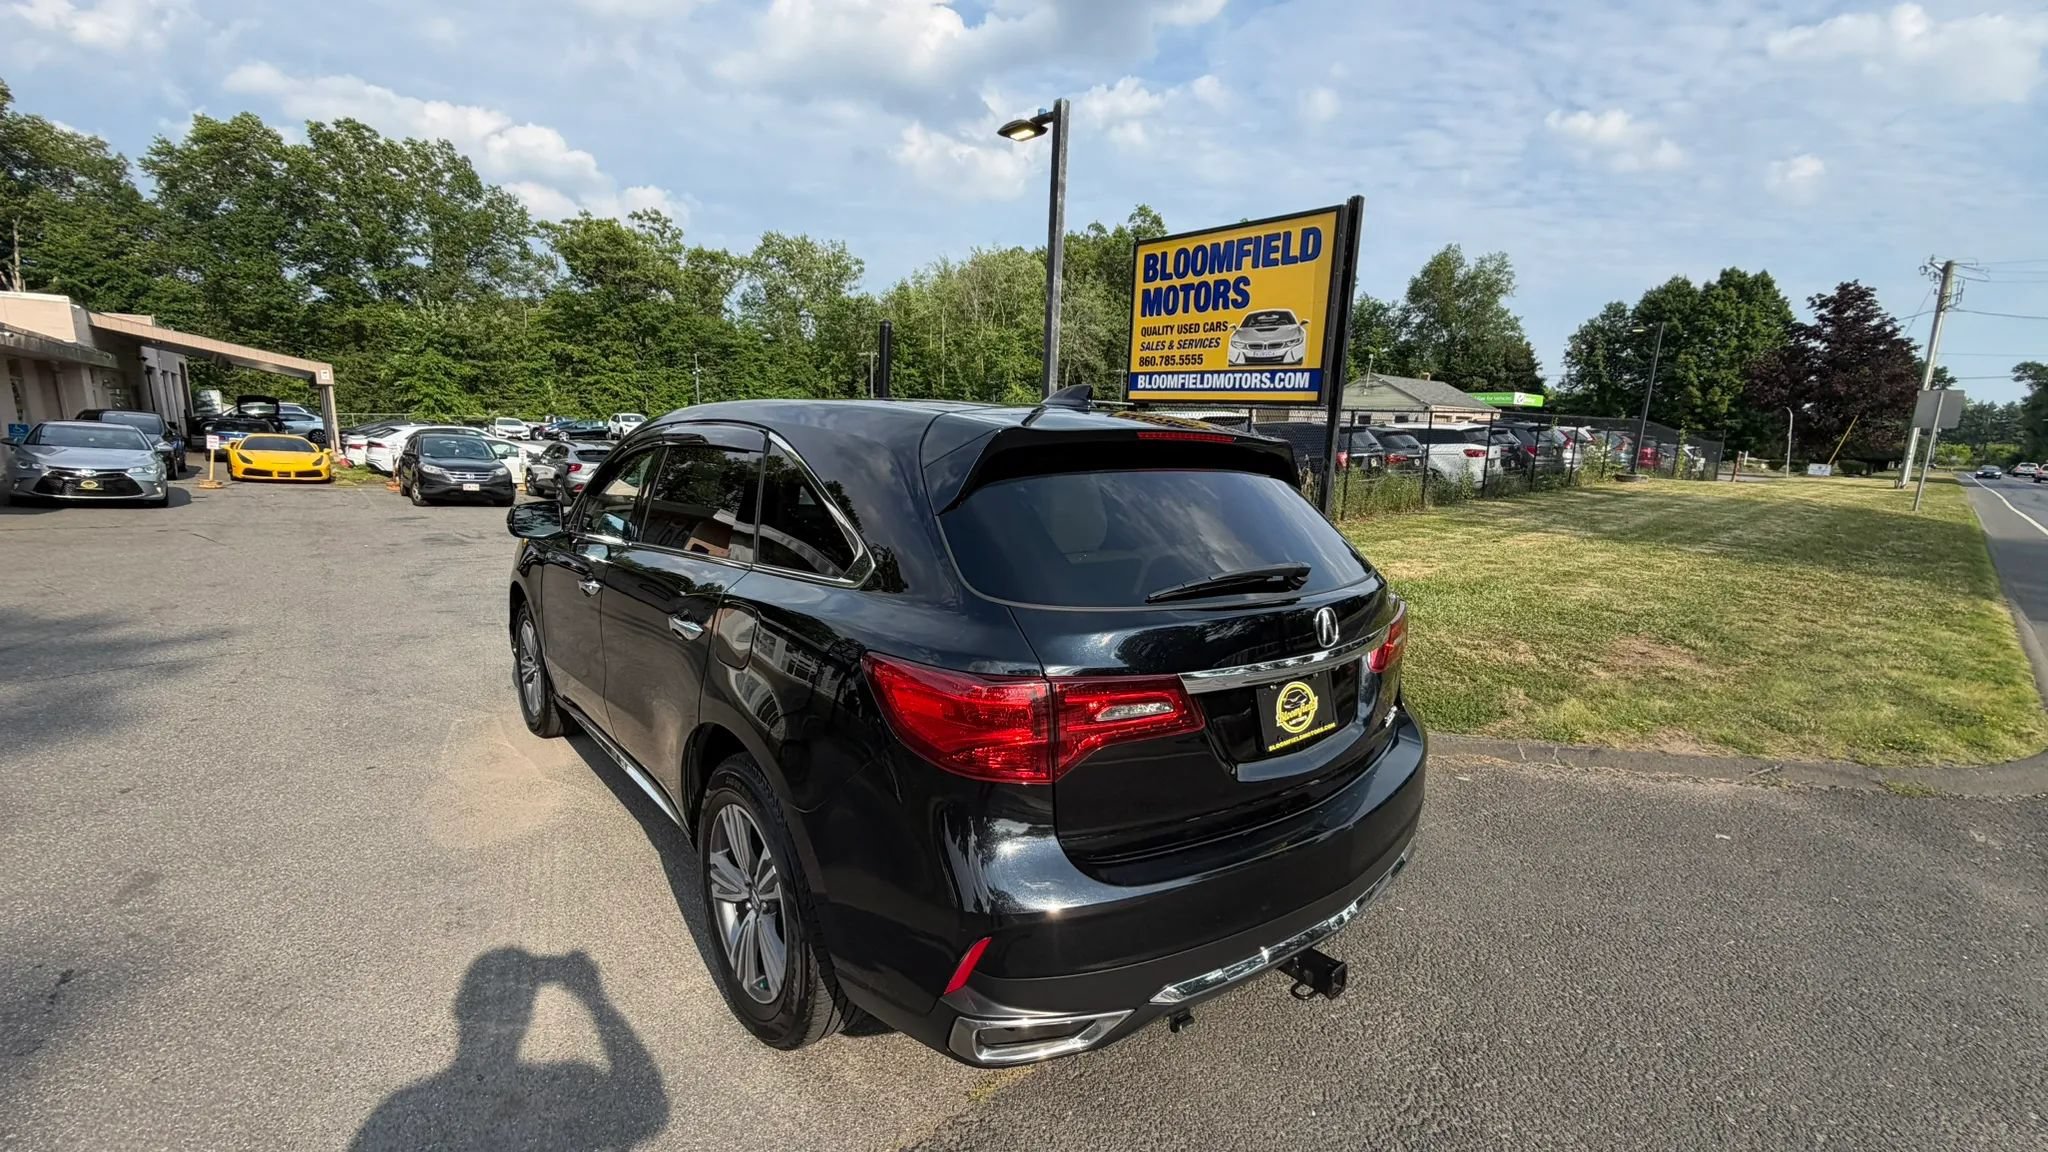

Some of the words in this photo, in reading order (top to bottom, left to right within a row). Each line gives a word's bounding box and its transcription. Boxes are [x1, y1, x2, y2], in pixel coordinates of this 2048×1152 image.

[1143, 227, 1322, 283] BLOOMFIELD
[1140, 276, 1251, 318] MOTORS
[1141, 325, 1175, 337] QUALITY
[1177, 323, 1200, 334] USED
[1203, 321, 1228, 332] CARS
[1140, 341, 1166, 351] SALES
[1168, 340, 1174, 350] &
[1177, 337, 1221, 349] SERVICES
[1139, 354, 1203, 367] 860.785.5555
[1137, 372, 1310, 389] BLOOMFIELDMOTORS.COM
